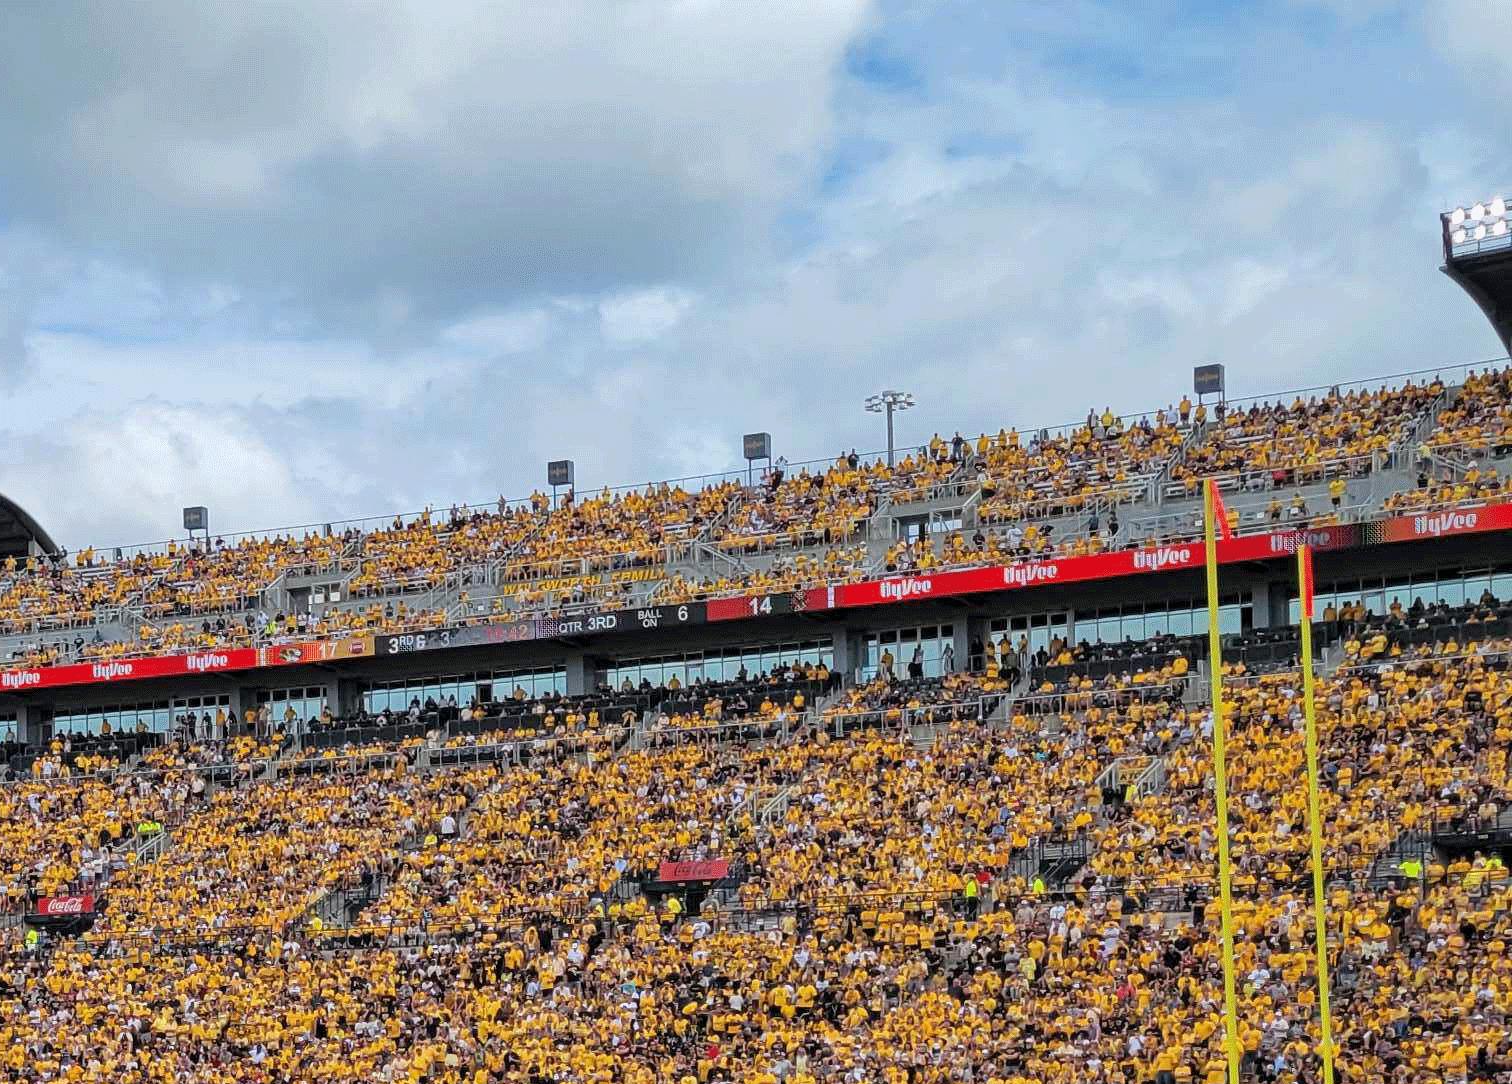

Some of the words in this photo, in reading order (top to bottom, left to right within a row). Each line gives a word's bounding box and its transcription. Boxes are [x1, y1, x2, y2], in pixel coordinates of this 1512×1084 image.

[1270, 530, 1331, 553] Hyee
[1134, 548, 1191, 571] HyVee
[1003, 564, 1059, 586] HyVee
[880, 579, 932, 600] HyVee
[637, 607, 662, 621] BALL
[750, 596, 774, 616] 14
[558, 621, 583, 634] QTR
[588, 615, 617, 631] 3RD
[642, 617, 659, 629] ON
[677, 605, 689, 622] 6
[319, 642, 338, 659] 17
[93, 661, 133, 680] HyVee
[187, 653, 229, 672] HyVee
[1, 671, 41, 689] HyVee
